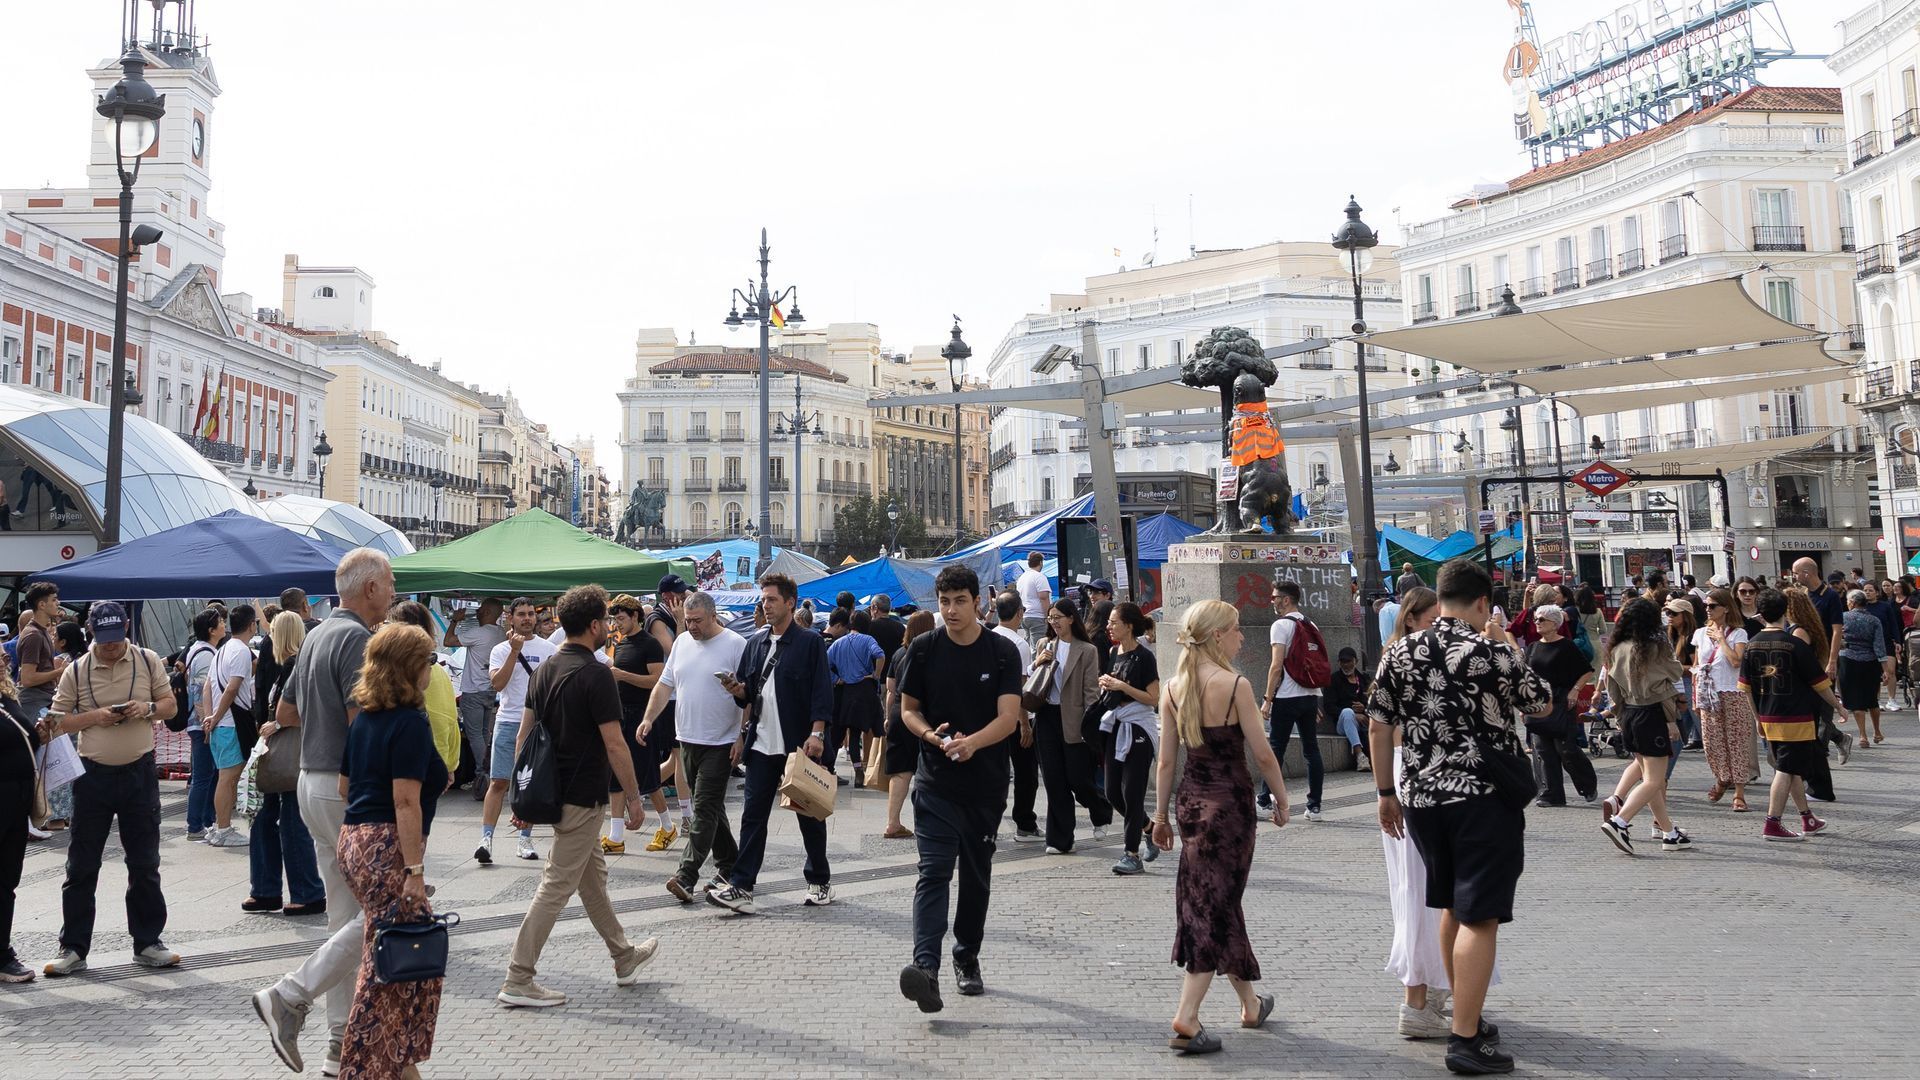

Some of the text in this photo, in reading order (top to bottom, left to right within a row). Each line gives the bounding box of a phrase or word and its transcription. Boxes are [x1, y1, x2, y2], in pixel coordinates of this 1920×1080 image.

[1543, 0, 1736, 81] TIO PE
[1677, 35, 1754, 90] BYASS
[1546, 89, 1565, 107] SOL
[1569, 83, 1581, 97] DE
[1661, 461, 1681, 475] 1919
[1588, 475, 1614, 483] Metro
[1137, 491, 1167, 499] PlayRenfe
[50, 512, 82, 521] PlayRen
[1781, 541, 1829, 549] SEPHORA
[1274, 566, 1345, 587] EAT THE
[1299, 588, 1329, 610] ICH
[804, 768, 829, 790] IUMAN
